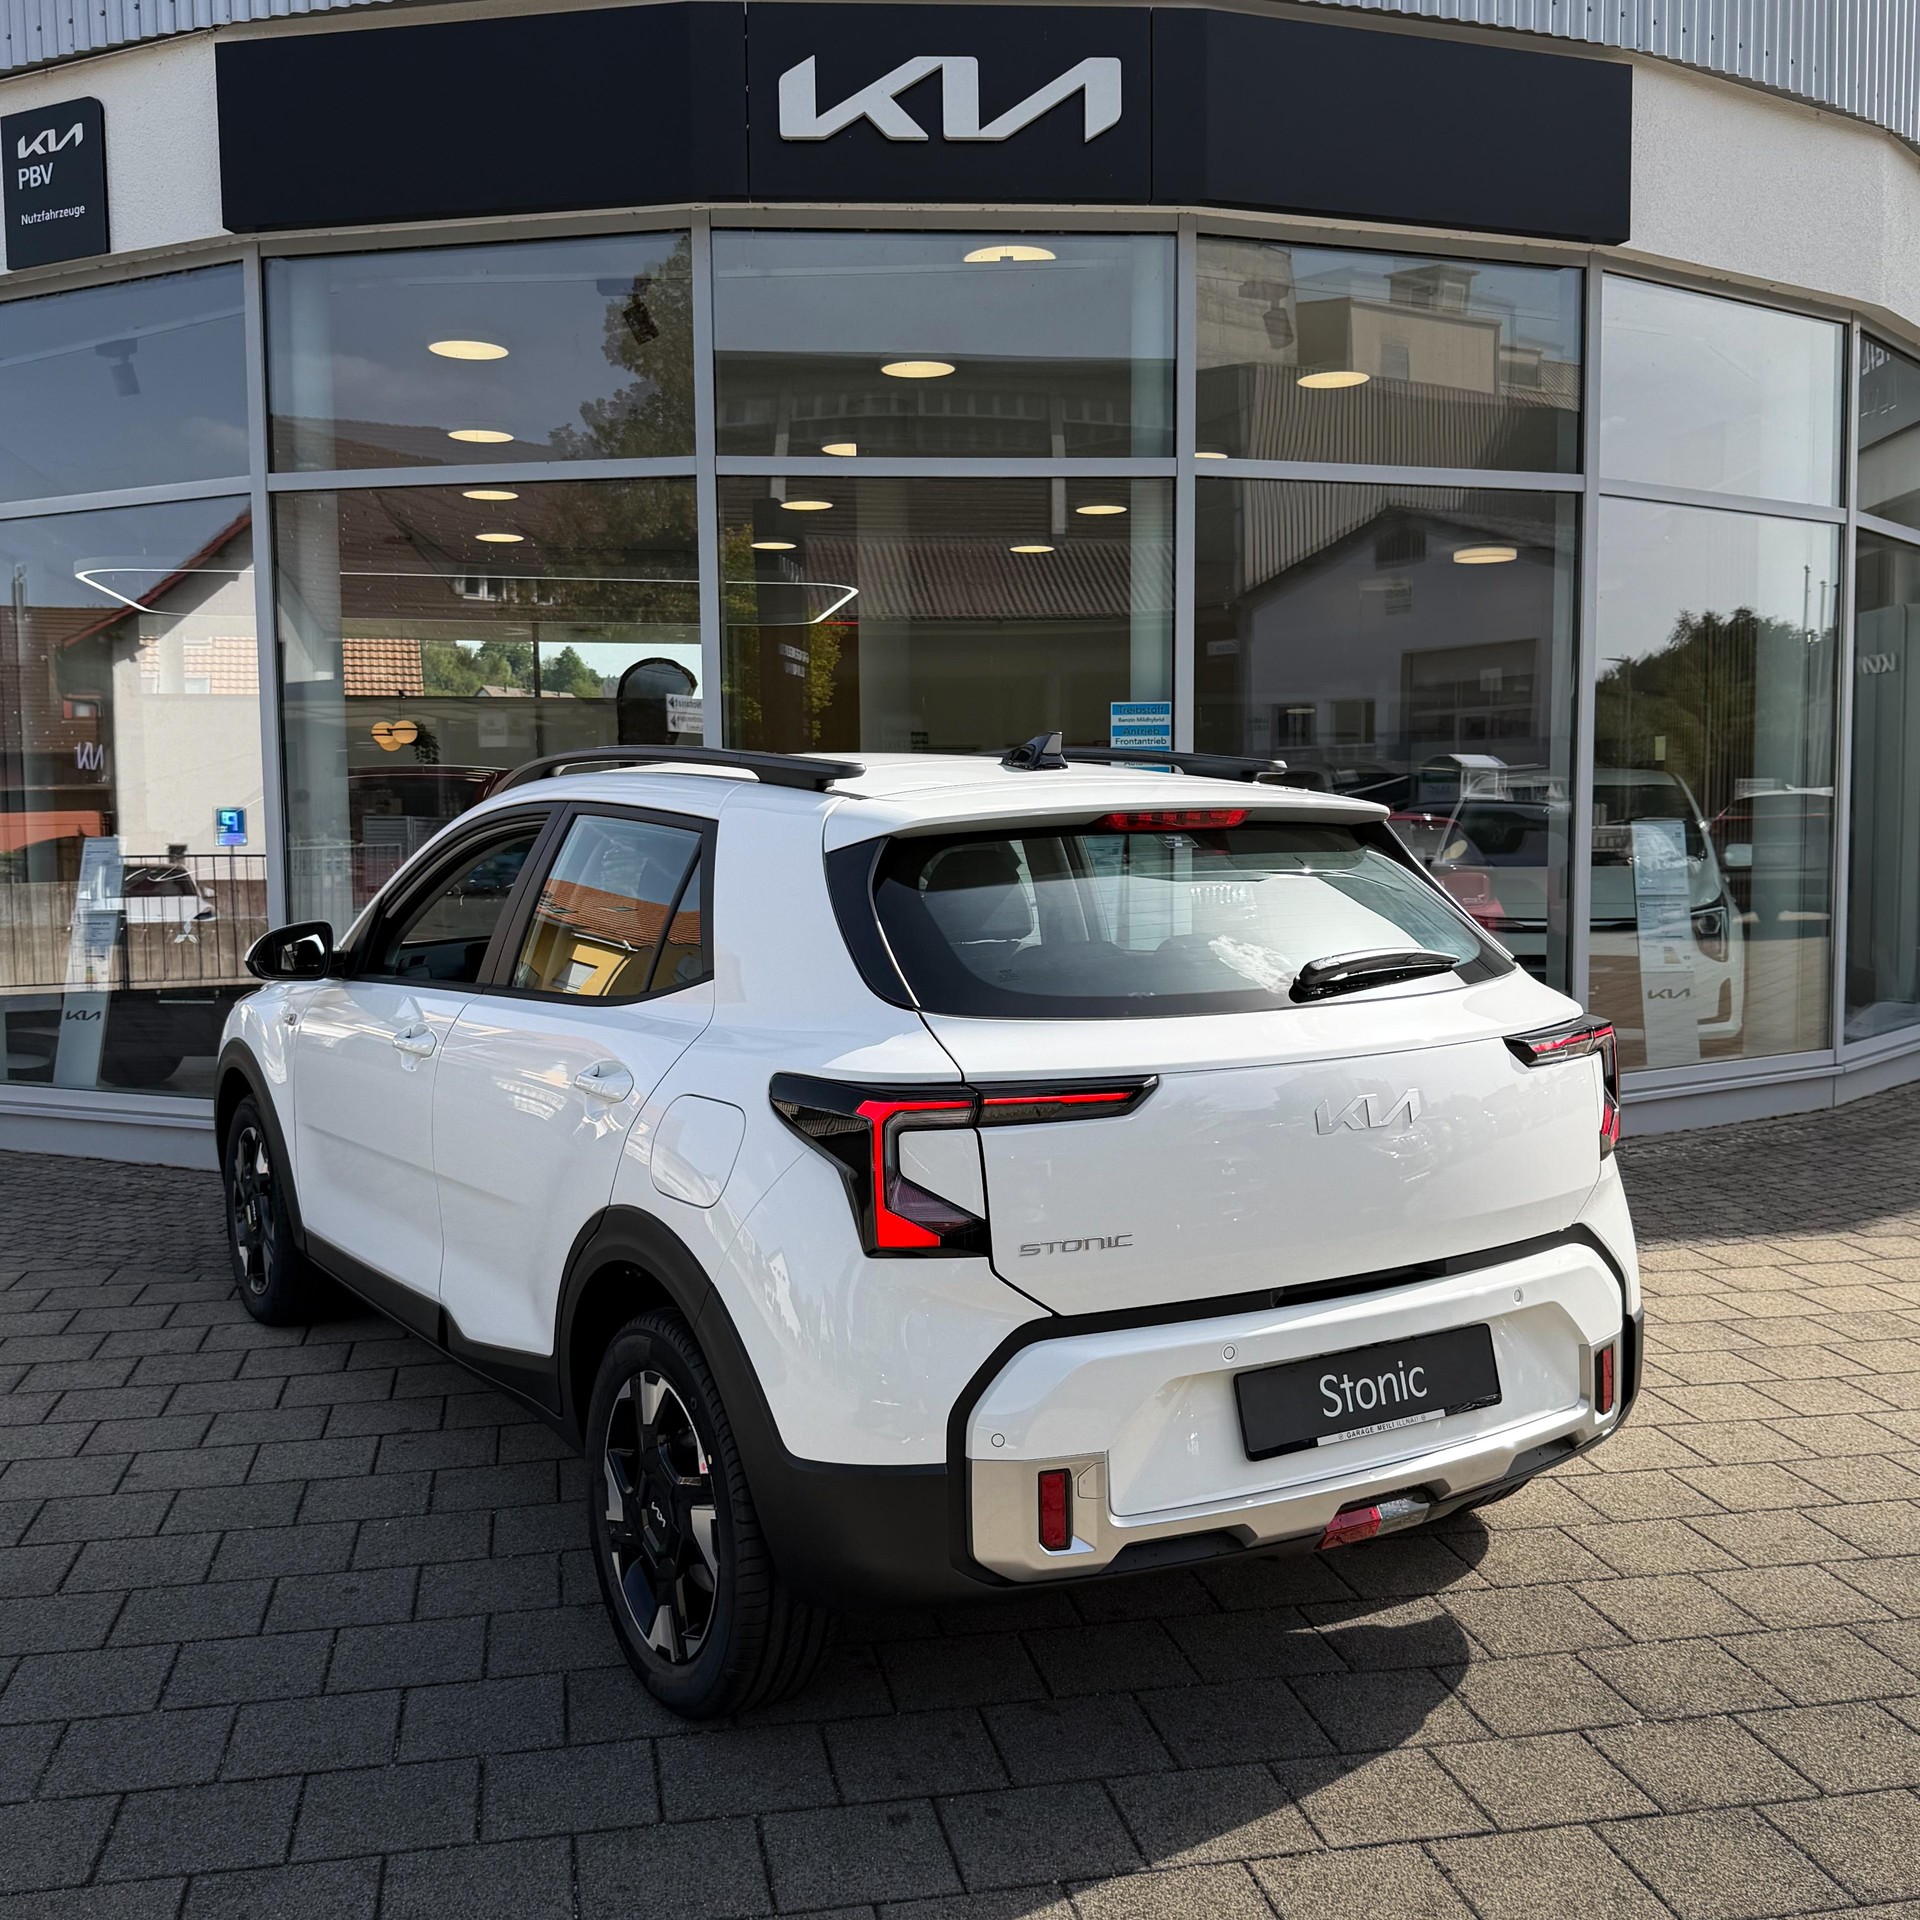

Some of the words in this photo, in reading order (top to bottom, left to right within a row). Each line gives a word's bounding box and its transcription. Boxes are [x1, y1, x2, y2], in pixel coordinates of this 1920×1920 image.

[778, 54, 1122, 143] KIA
[17, 122, 84, 159] KIA
[18, 162, 54, 190] PBV
[21, 205, 85, 225] Nutzfahrzeuge
[1118, 704, 1164, 715] Treibstoff
[1136, 716, 1165, 724] Mildhybrid
[1123, 726, 1160, 736] Antrieb
[1115, 737, 1167, 745] Frontantrieb
[1647, 987, 1690, 999] KIA
[65, 1009, 101, 1021] KIA
[1314, 1087, 1422, 1135] KIA
[1018, 1233, 1134, 1257] STONIC
[1319, 1360, 1428, 1418] Stonic
[1346, 1426, 1375, 1439] GARAGE
[1376, 1421, 1396, 1433] MEILI
